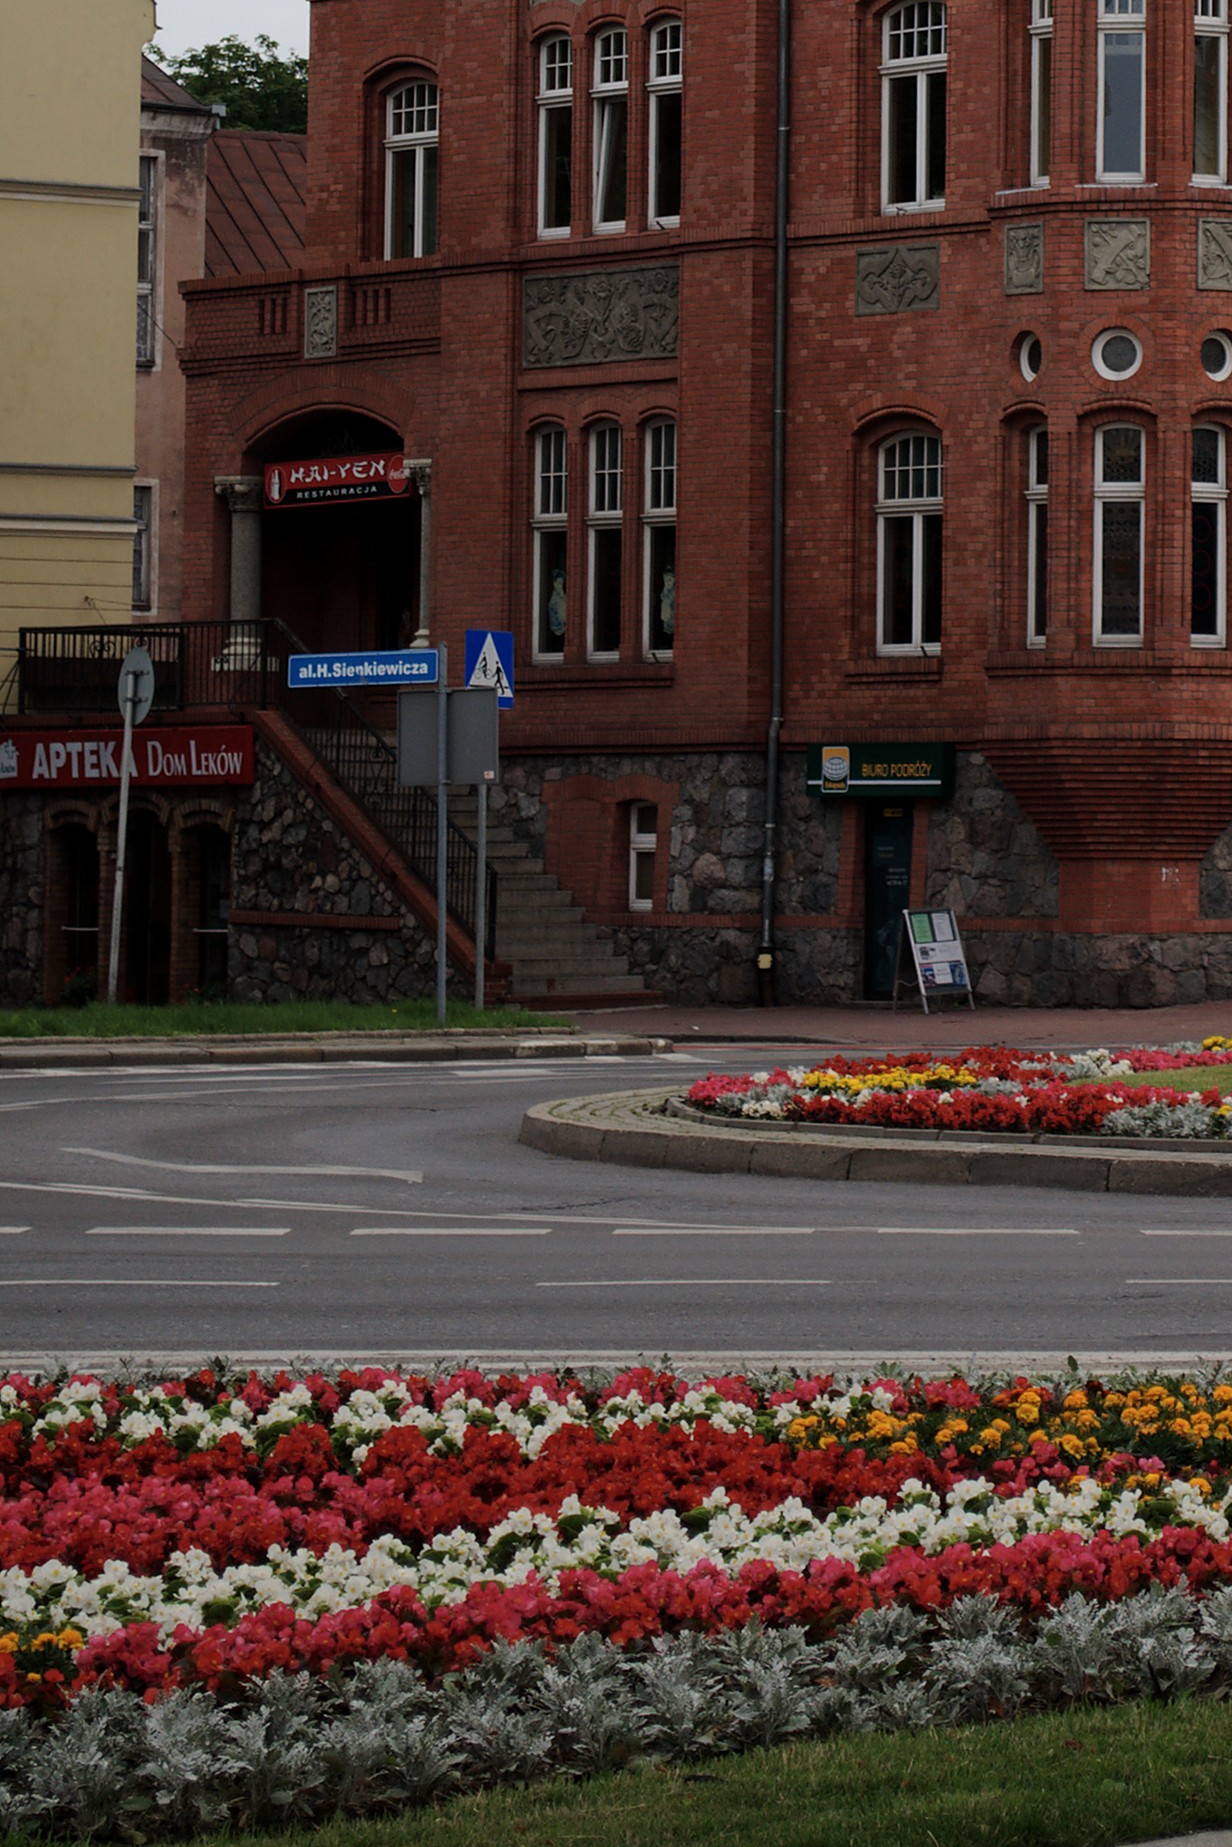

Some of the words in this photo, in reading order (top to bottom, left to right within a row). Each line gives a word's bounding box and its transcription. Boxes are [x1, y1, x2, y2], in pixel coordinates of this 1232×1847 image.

[289, 459, 386, 484] HAI-YEN
[296, 485, 378, 500] RESTAURACJA
[299, 660, 429, 679] al.H.Sienkiewicza
[861, 763, 888, 777] BIURO
[890, 760, 933, 777] PODRÓŻY
